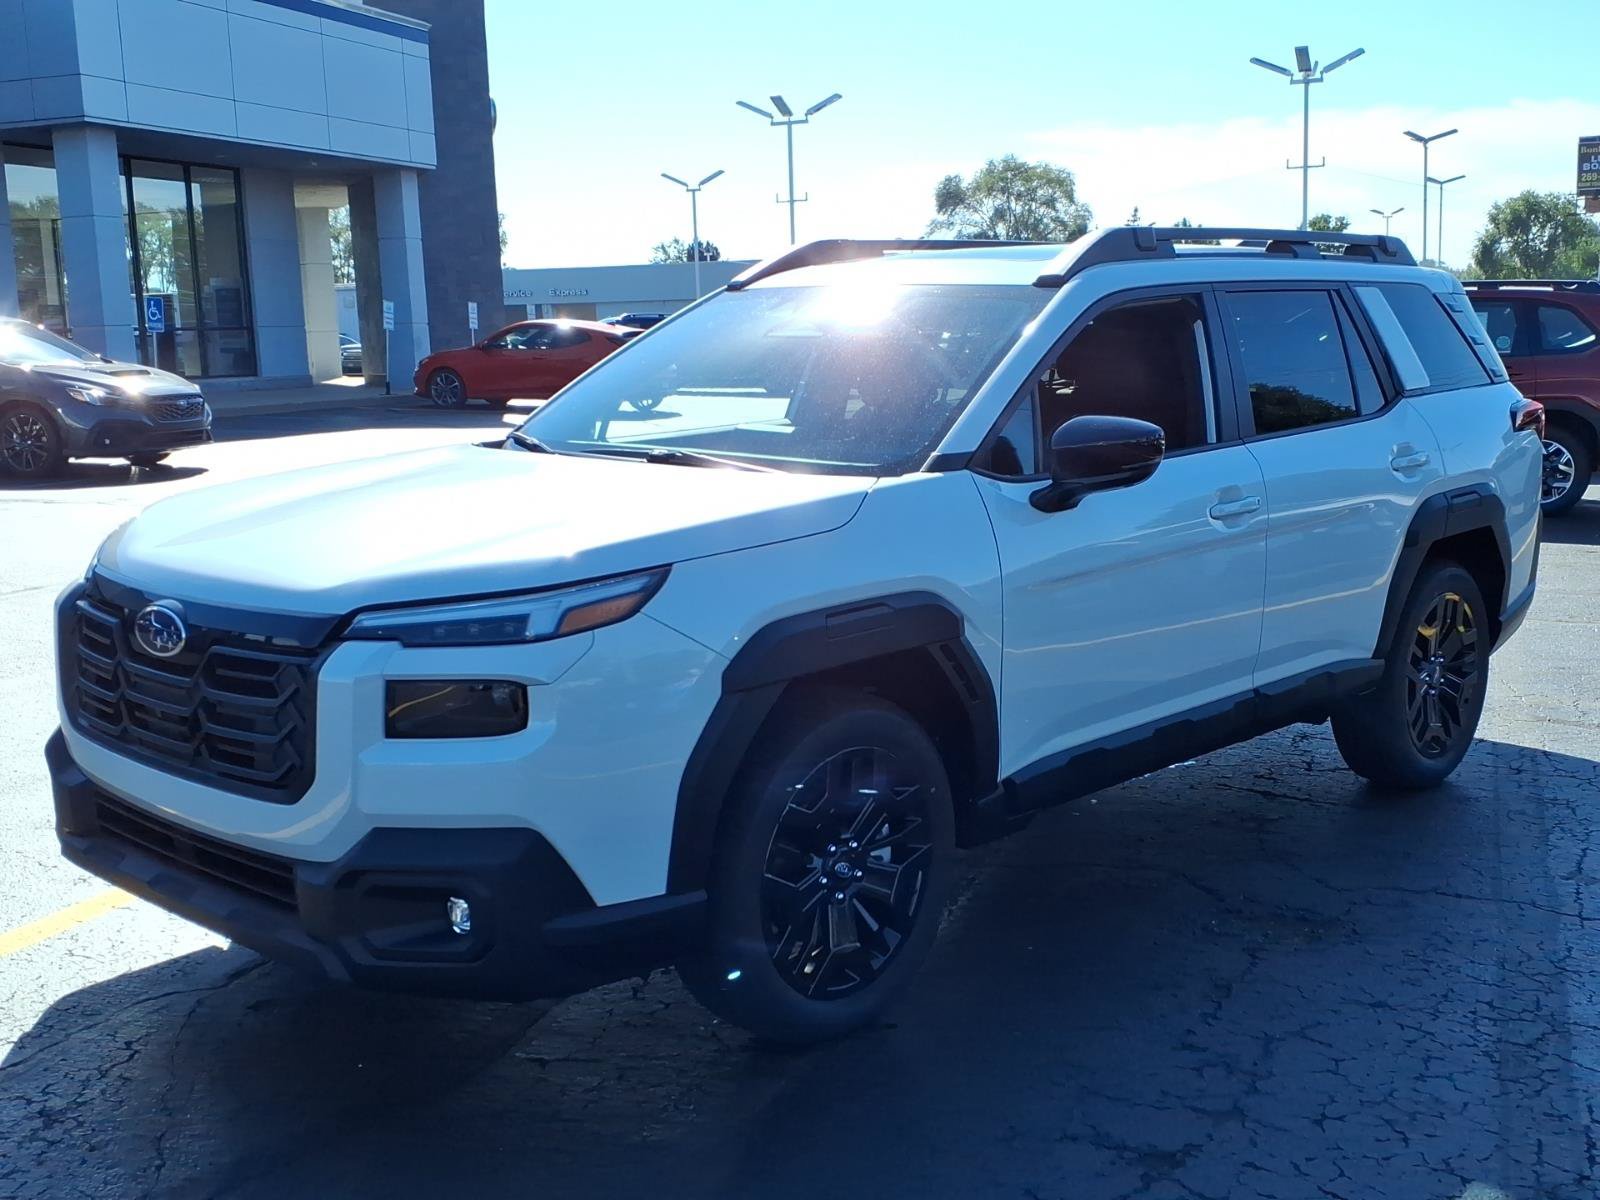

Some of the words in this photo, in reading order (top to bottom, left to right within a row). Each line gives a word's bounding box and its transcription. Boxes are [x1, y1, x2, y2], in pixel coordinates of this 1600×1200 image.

[1583, 162, 1600, 170] BO
[503, 289, 532, 298] ervice
[548, 288, 588, 298] Express
